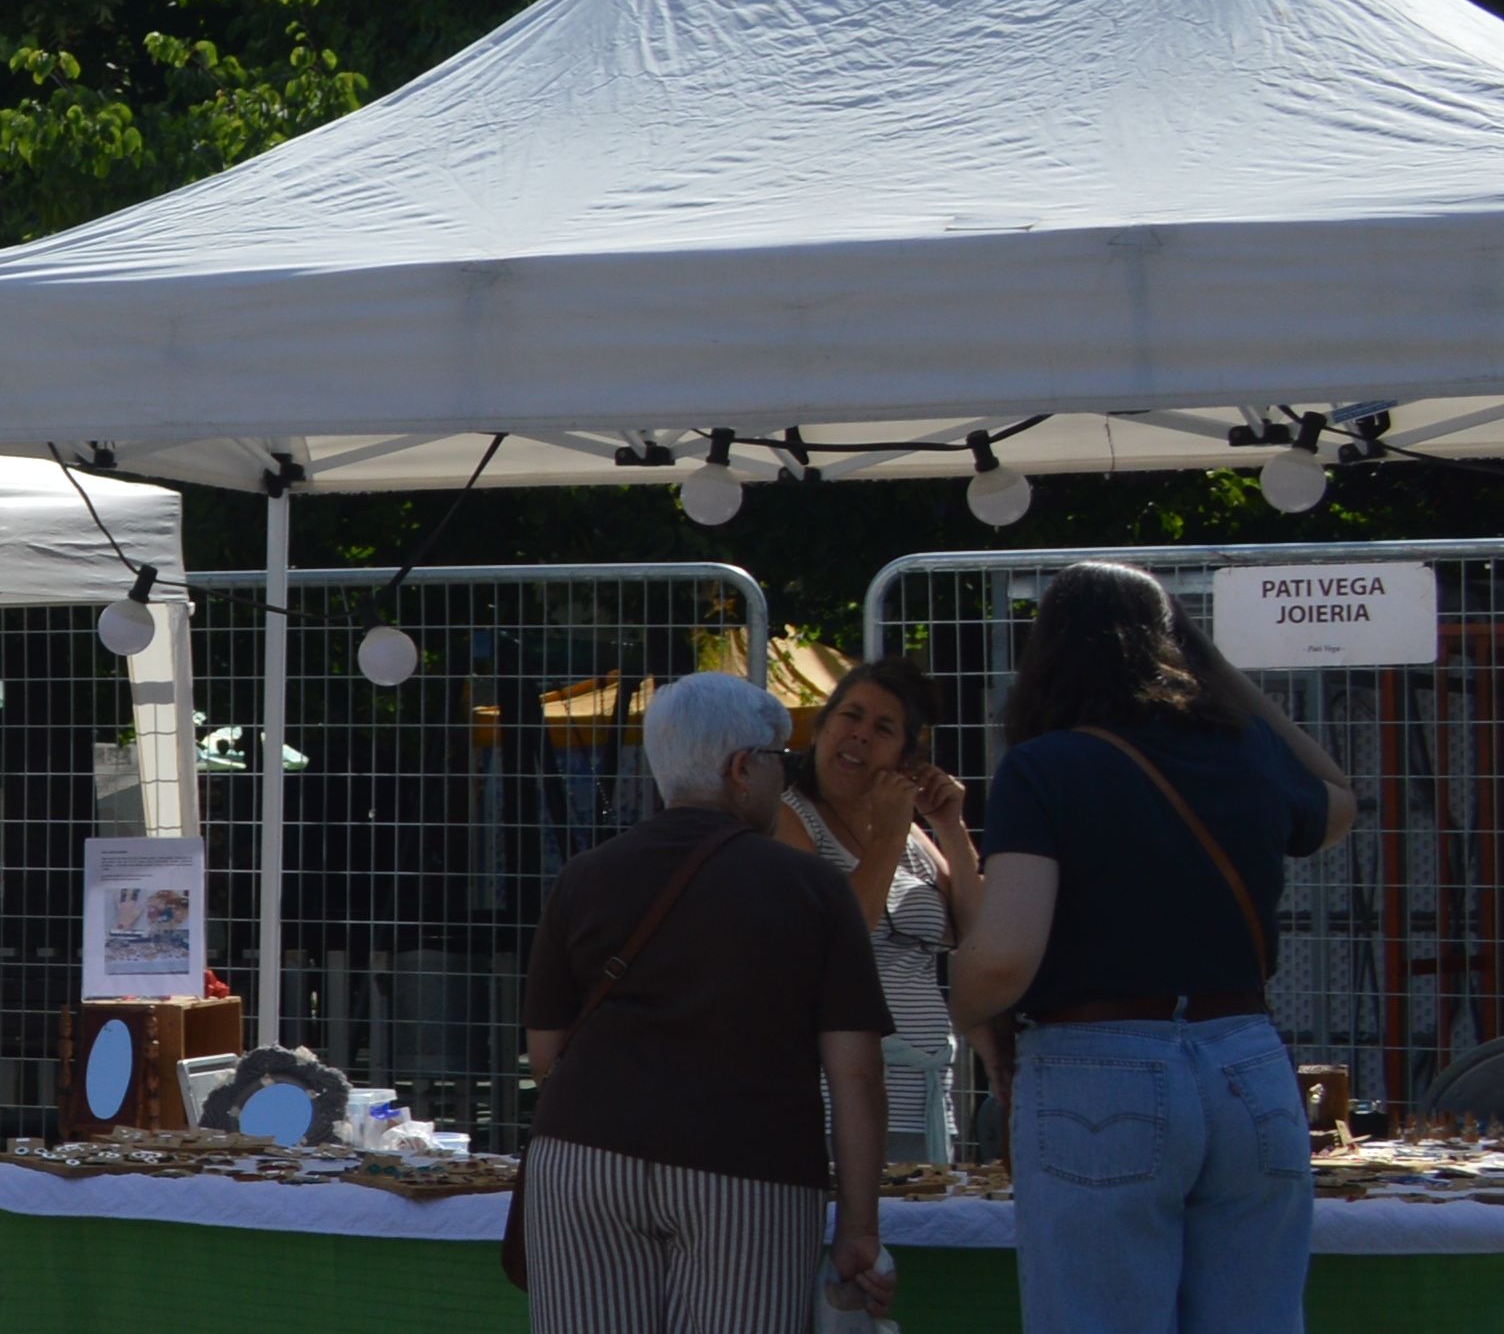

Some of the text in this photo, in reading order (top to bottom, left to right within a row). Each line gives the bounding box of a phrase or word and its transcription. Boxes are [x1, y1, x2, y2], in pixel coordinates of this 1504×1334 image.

[1262, 577, 1385, 598] PATI VEGA
[1276, 604, 1371, 624] JOIERIA
